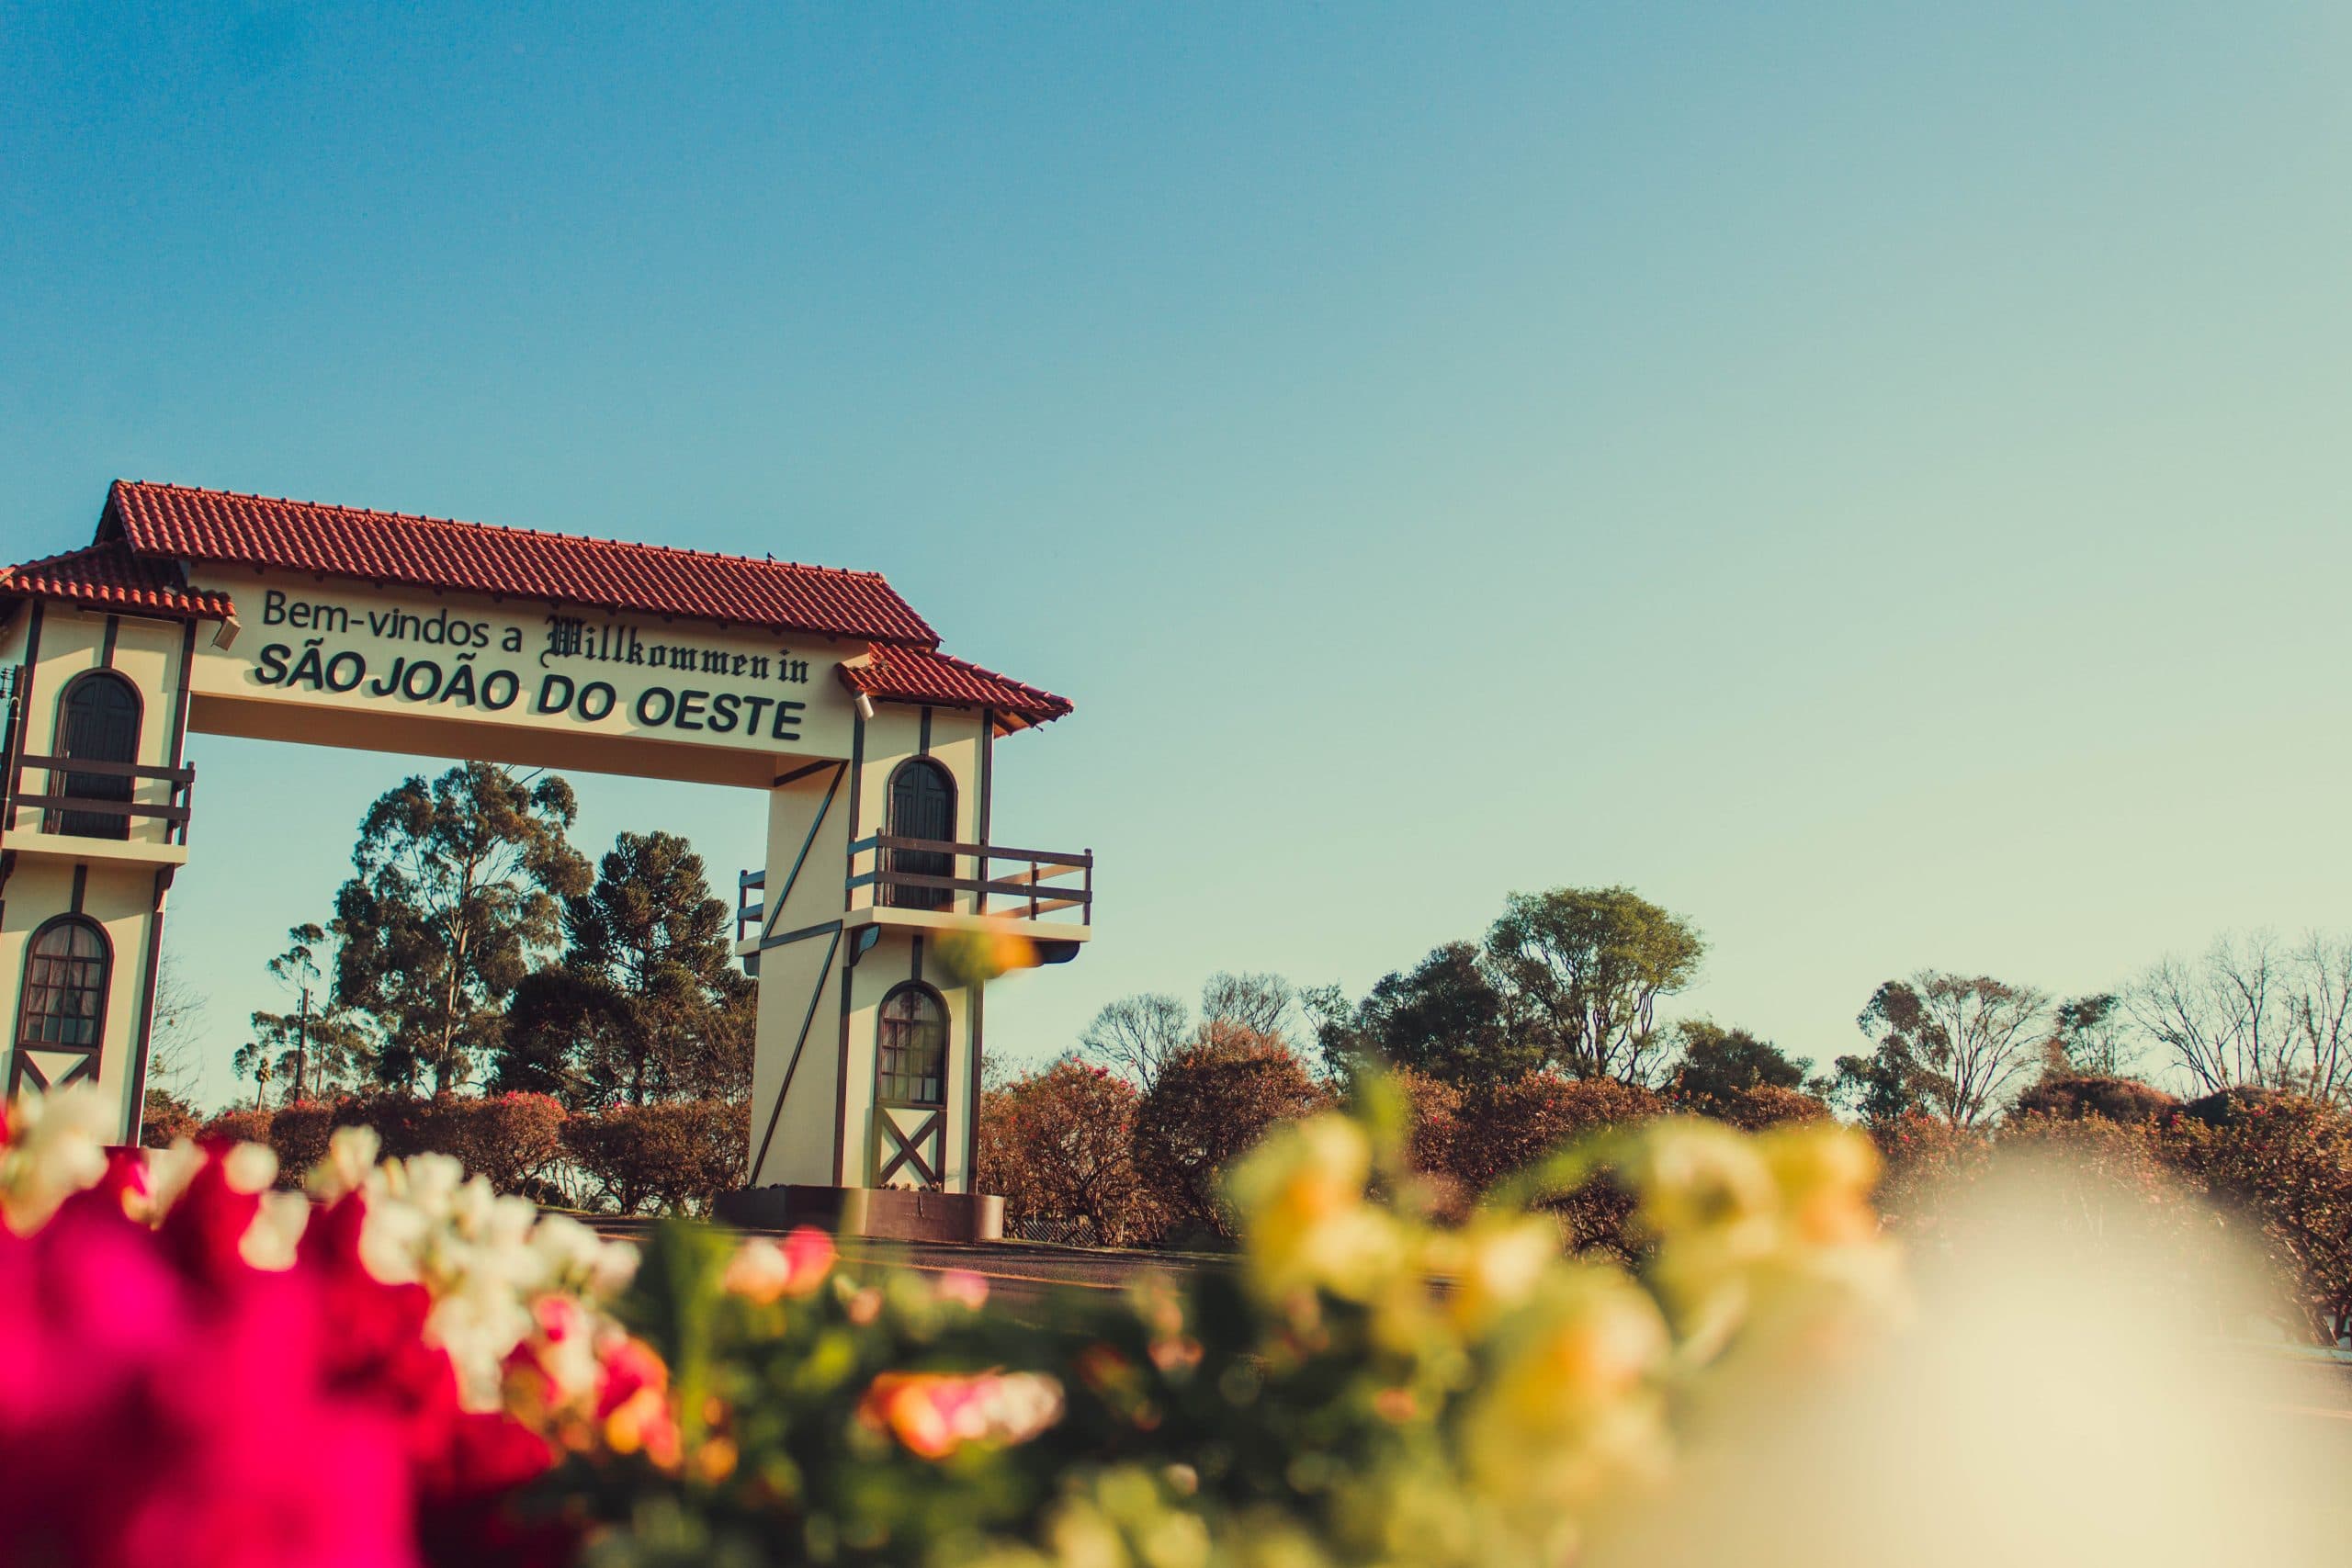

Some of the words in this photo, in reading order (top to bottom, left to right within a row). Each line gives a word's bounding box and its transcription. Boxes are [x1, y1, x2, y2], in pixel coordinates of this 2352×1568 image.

[254, 637, 367, 693] SÃO
[372, 652, 521, 711] JOÃO
[537, 673, 616, 722] DO
[637, 687, 807, 741] OESTE
[502, 626, 523, 653] a
[540, 614, 771, 681] Willkommen
[778, 648, 809, 684] in
